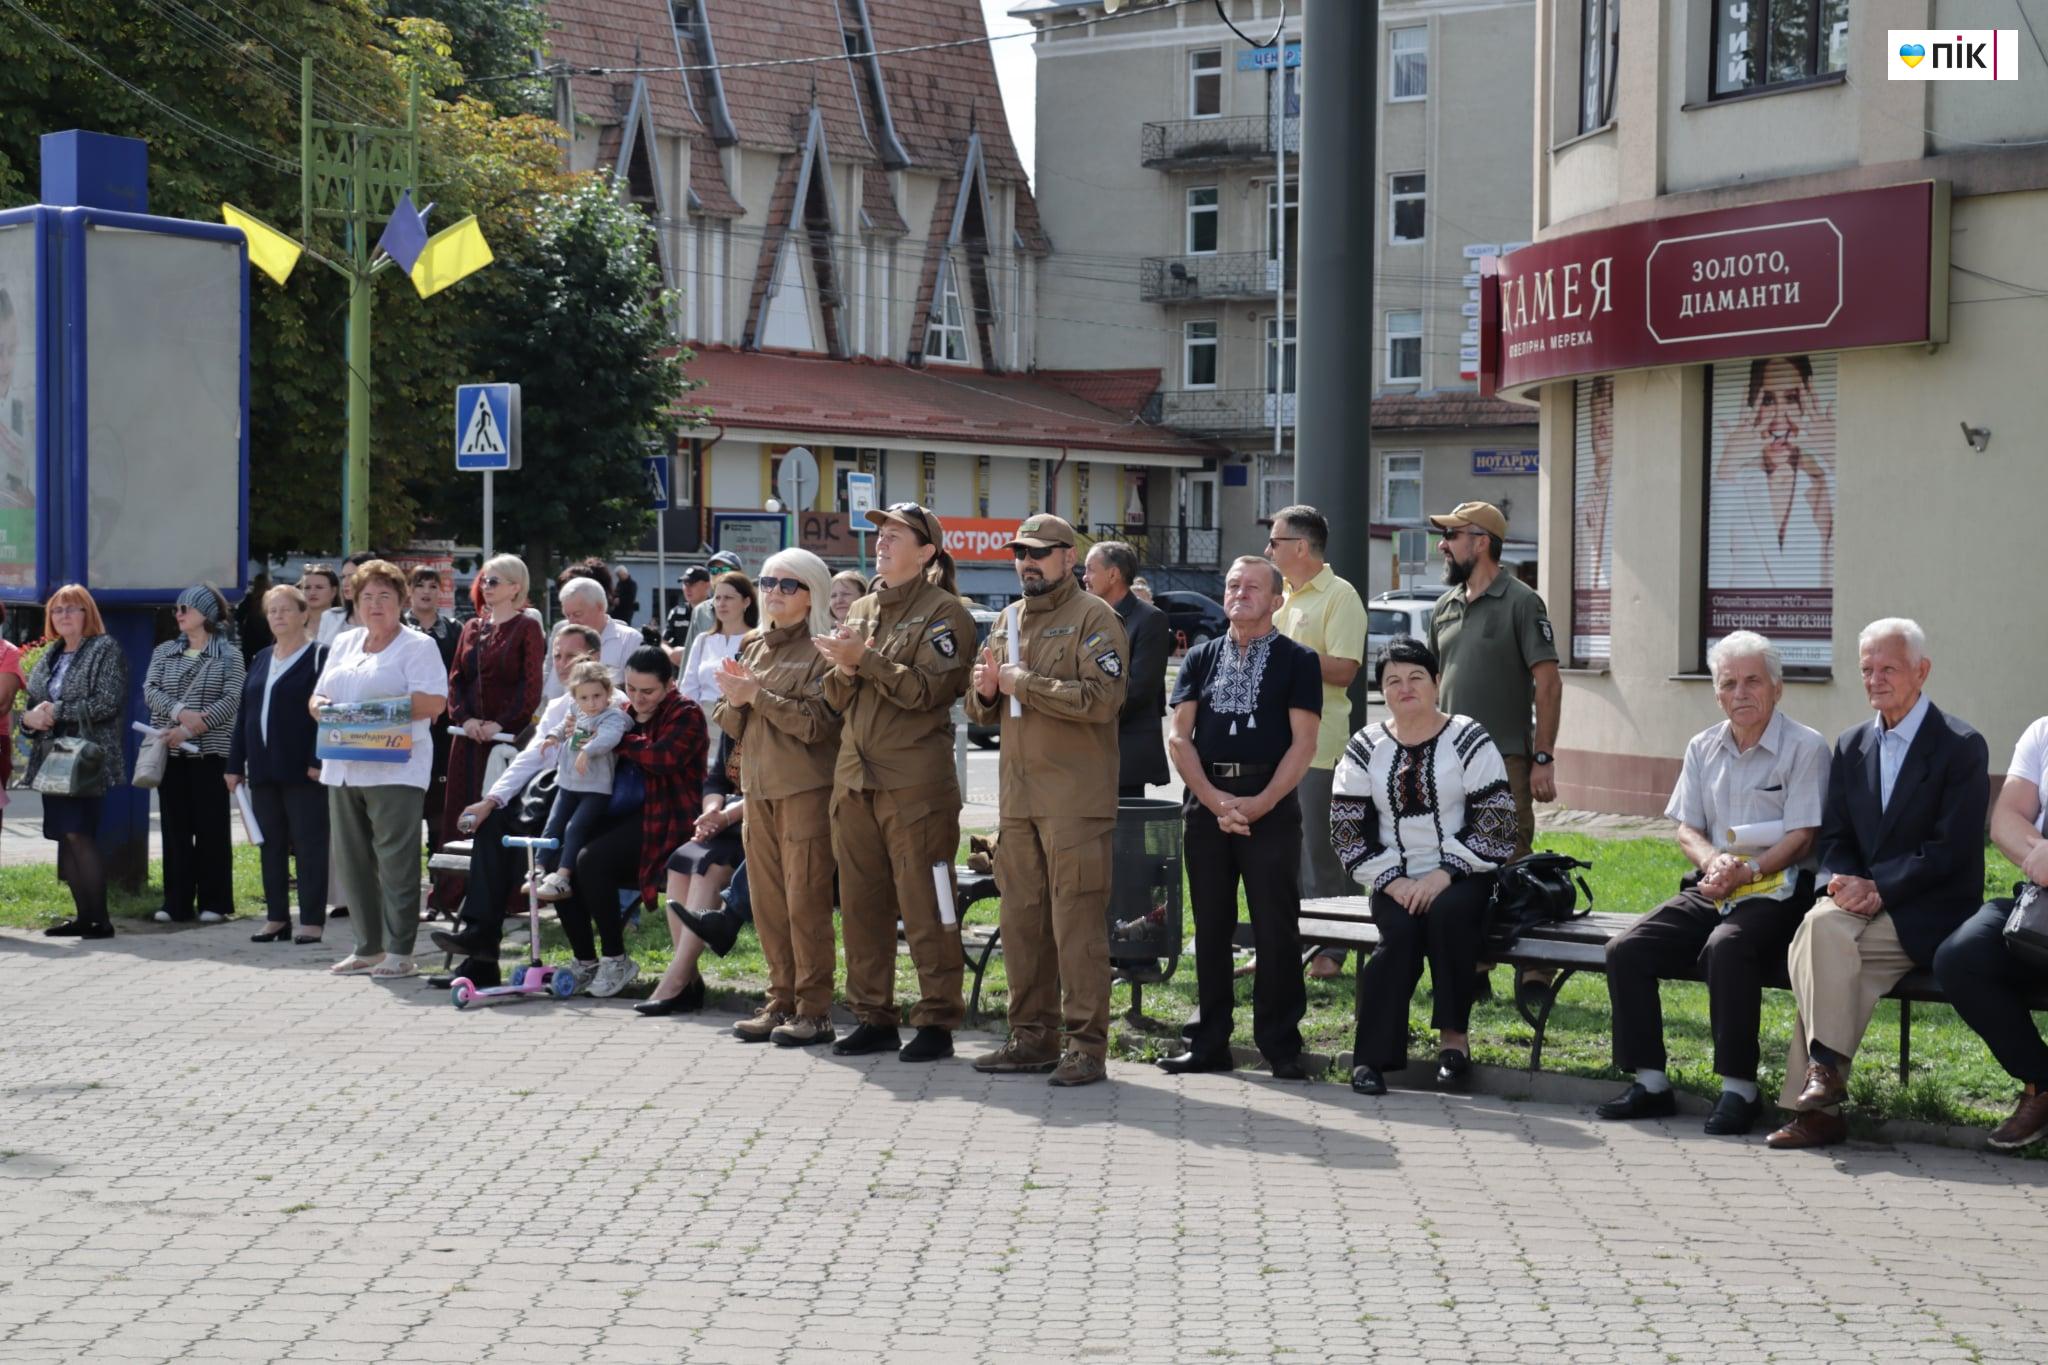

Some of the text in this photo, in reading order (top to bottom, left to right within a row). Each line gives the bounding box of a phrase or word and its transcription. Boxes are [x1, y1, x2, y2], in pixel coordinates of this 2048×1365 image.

[1255, 50, 1295, 66] ЦЕНР
[1692, 250, 1790, 282] ЗОЛОТО,
[1501, 256, 1613, 336] КАМЕЯ
[1679, 281, 1800, 319] ДІАМАНТИ
[1550, 330, 1593, 350] МЕРЕЖА
[942, 530, 1014, 554] кстрот
